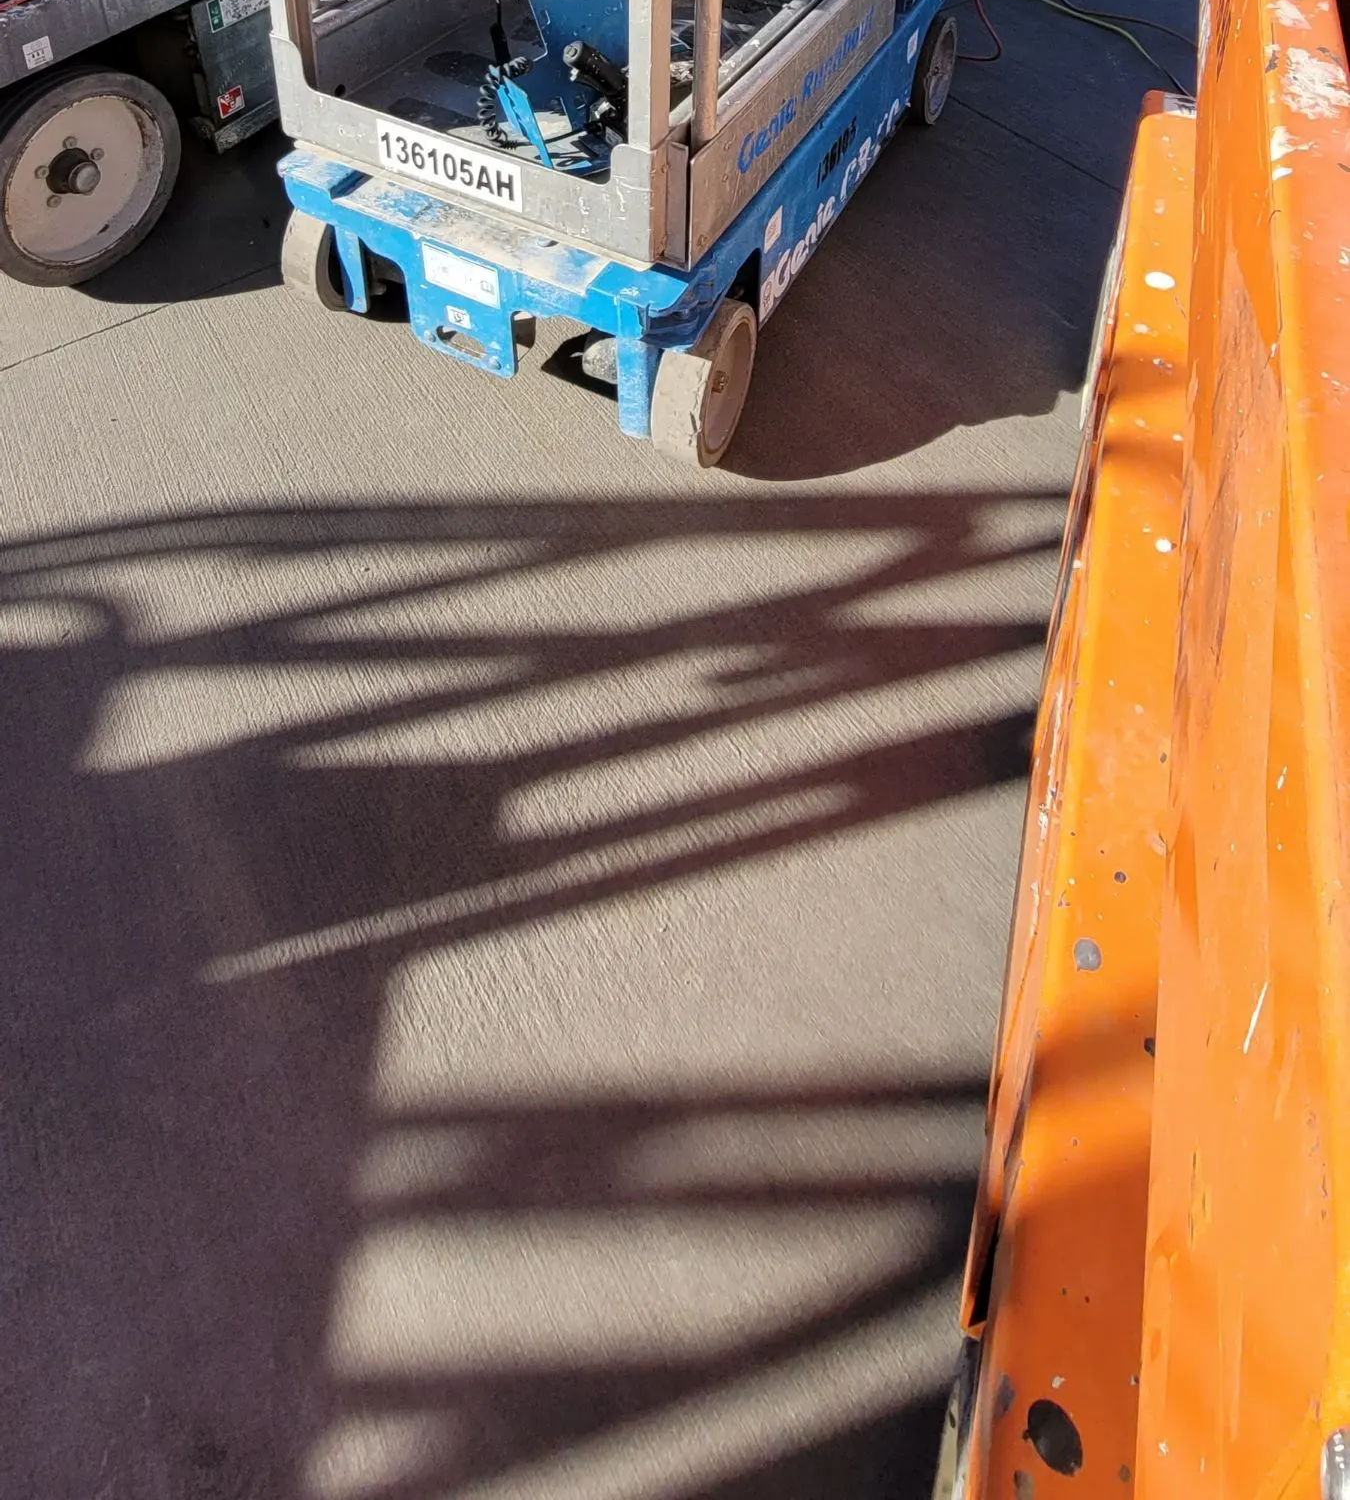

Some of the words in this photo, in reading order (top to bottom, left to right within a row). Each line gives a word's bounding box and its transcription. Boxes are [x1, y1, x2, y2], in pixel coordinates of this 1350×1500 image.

[380, 131, 516, 201] 136105AH
[736, 97, 798, 174] Genie
[774, 196, 836, 298] Genie
